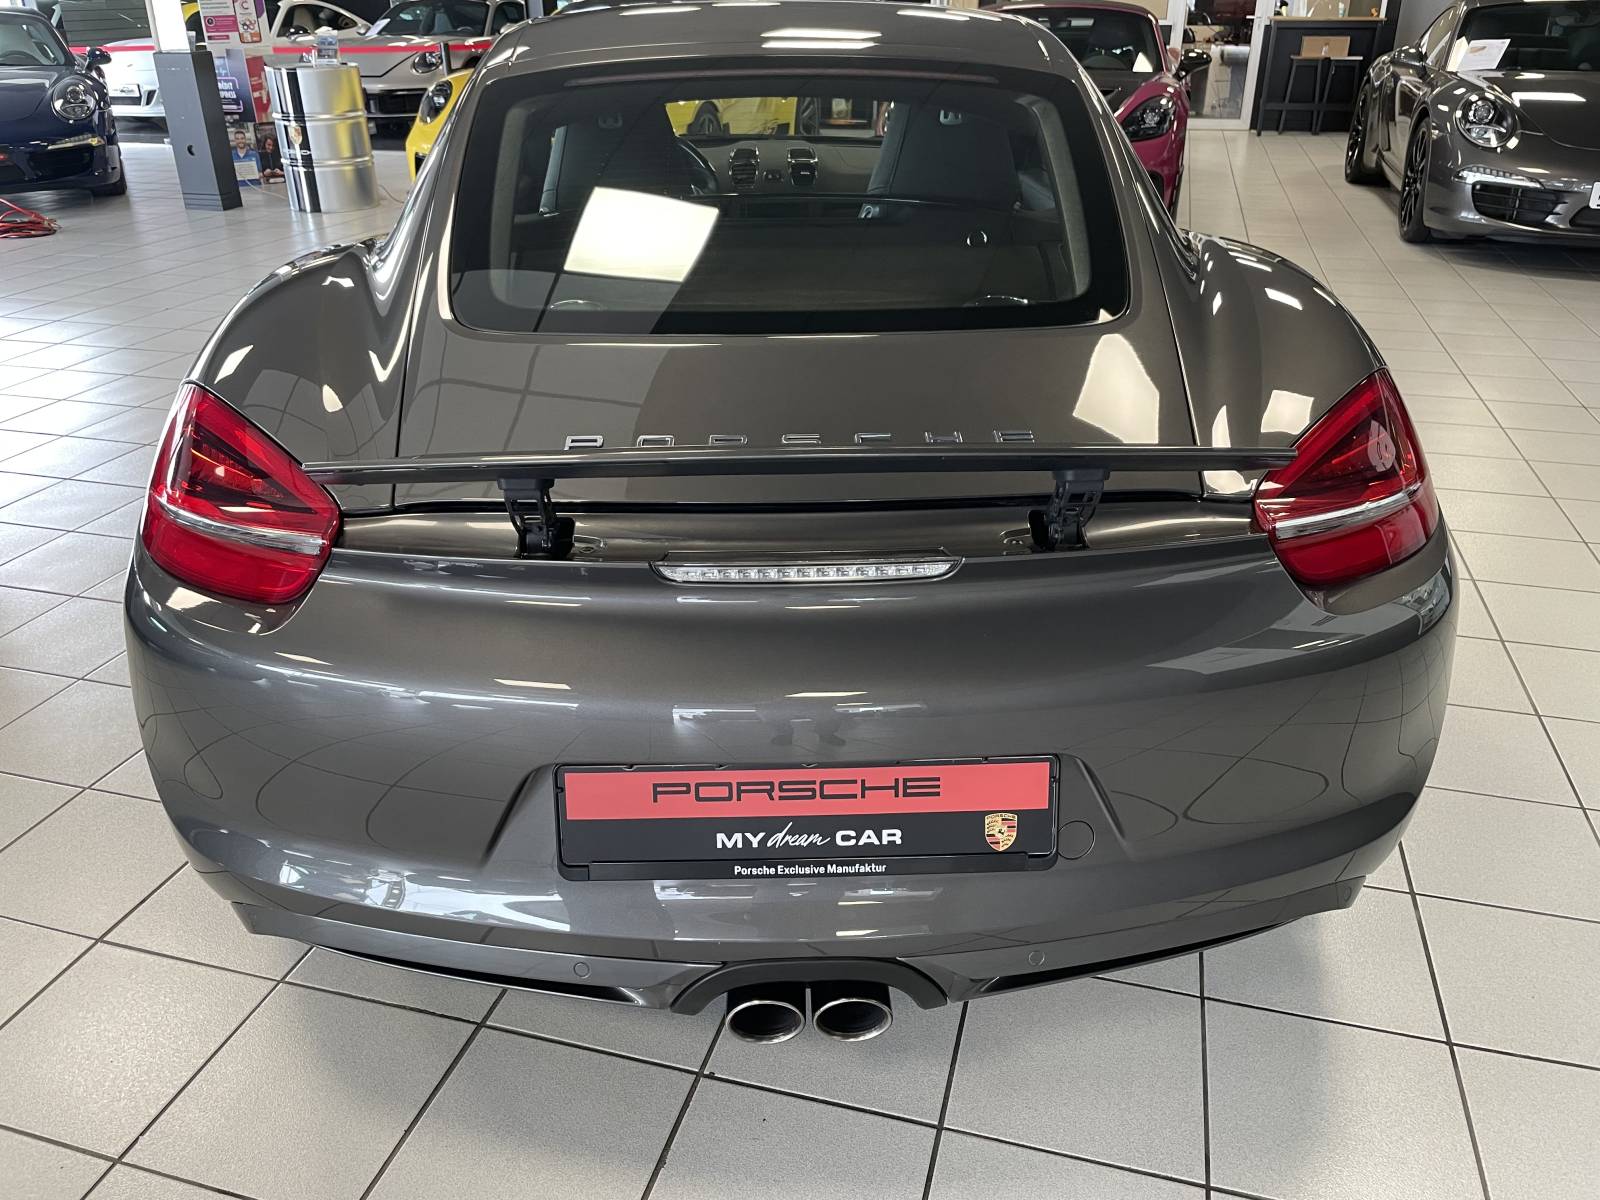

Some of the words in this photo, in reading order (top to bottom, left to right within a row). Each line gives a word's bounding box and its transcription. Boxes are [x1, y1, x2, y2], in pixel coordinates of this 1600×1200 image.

[652, 777, 941, 803] PORSCHE
[716, 832, 766, 849] MY
[767, 822, 831, 848] dream
[835, 829, 902, 846] CAR
[734, 865, 776, 876] Porsche
[777, 864, 826, 876] Exclusive
[827, 863, 887, 874] Manufaktur
